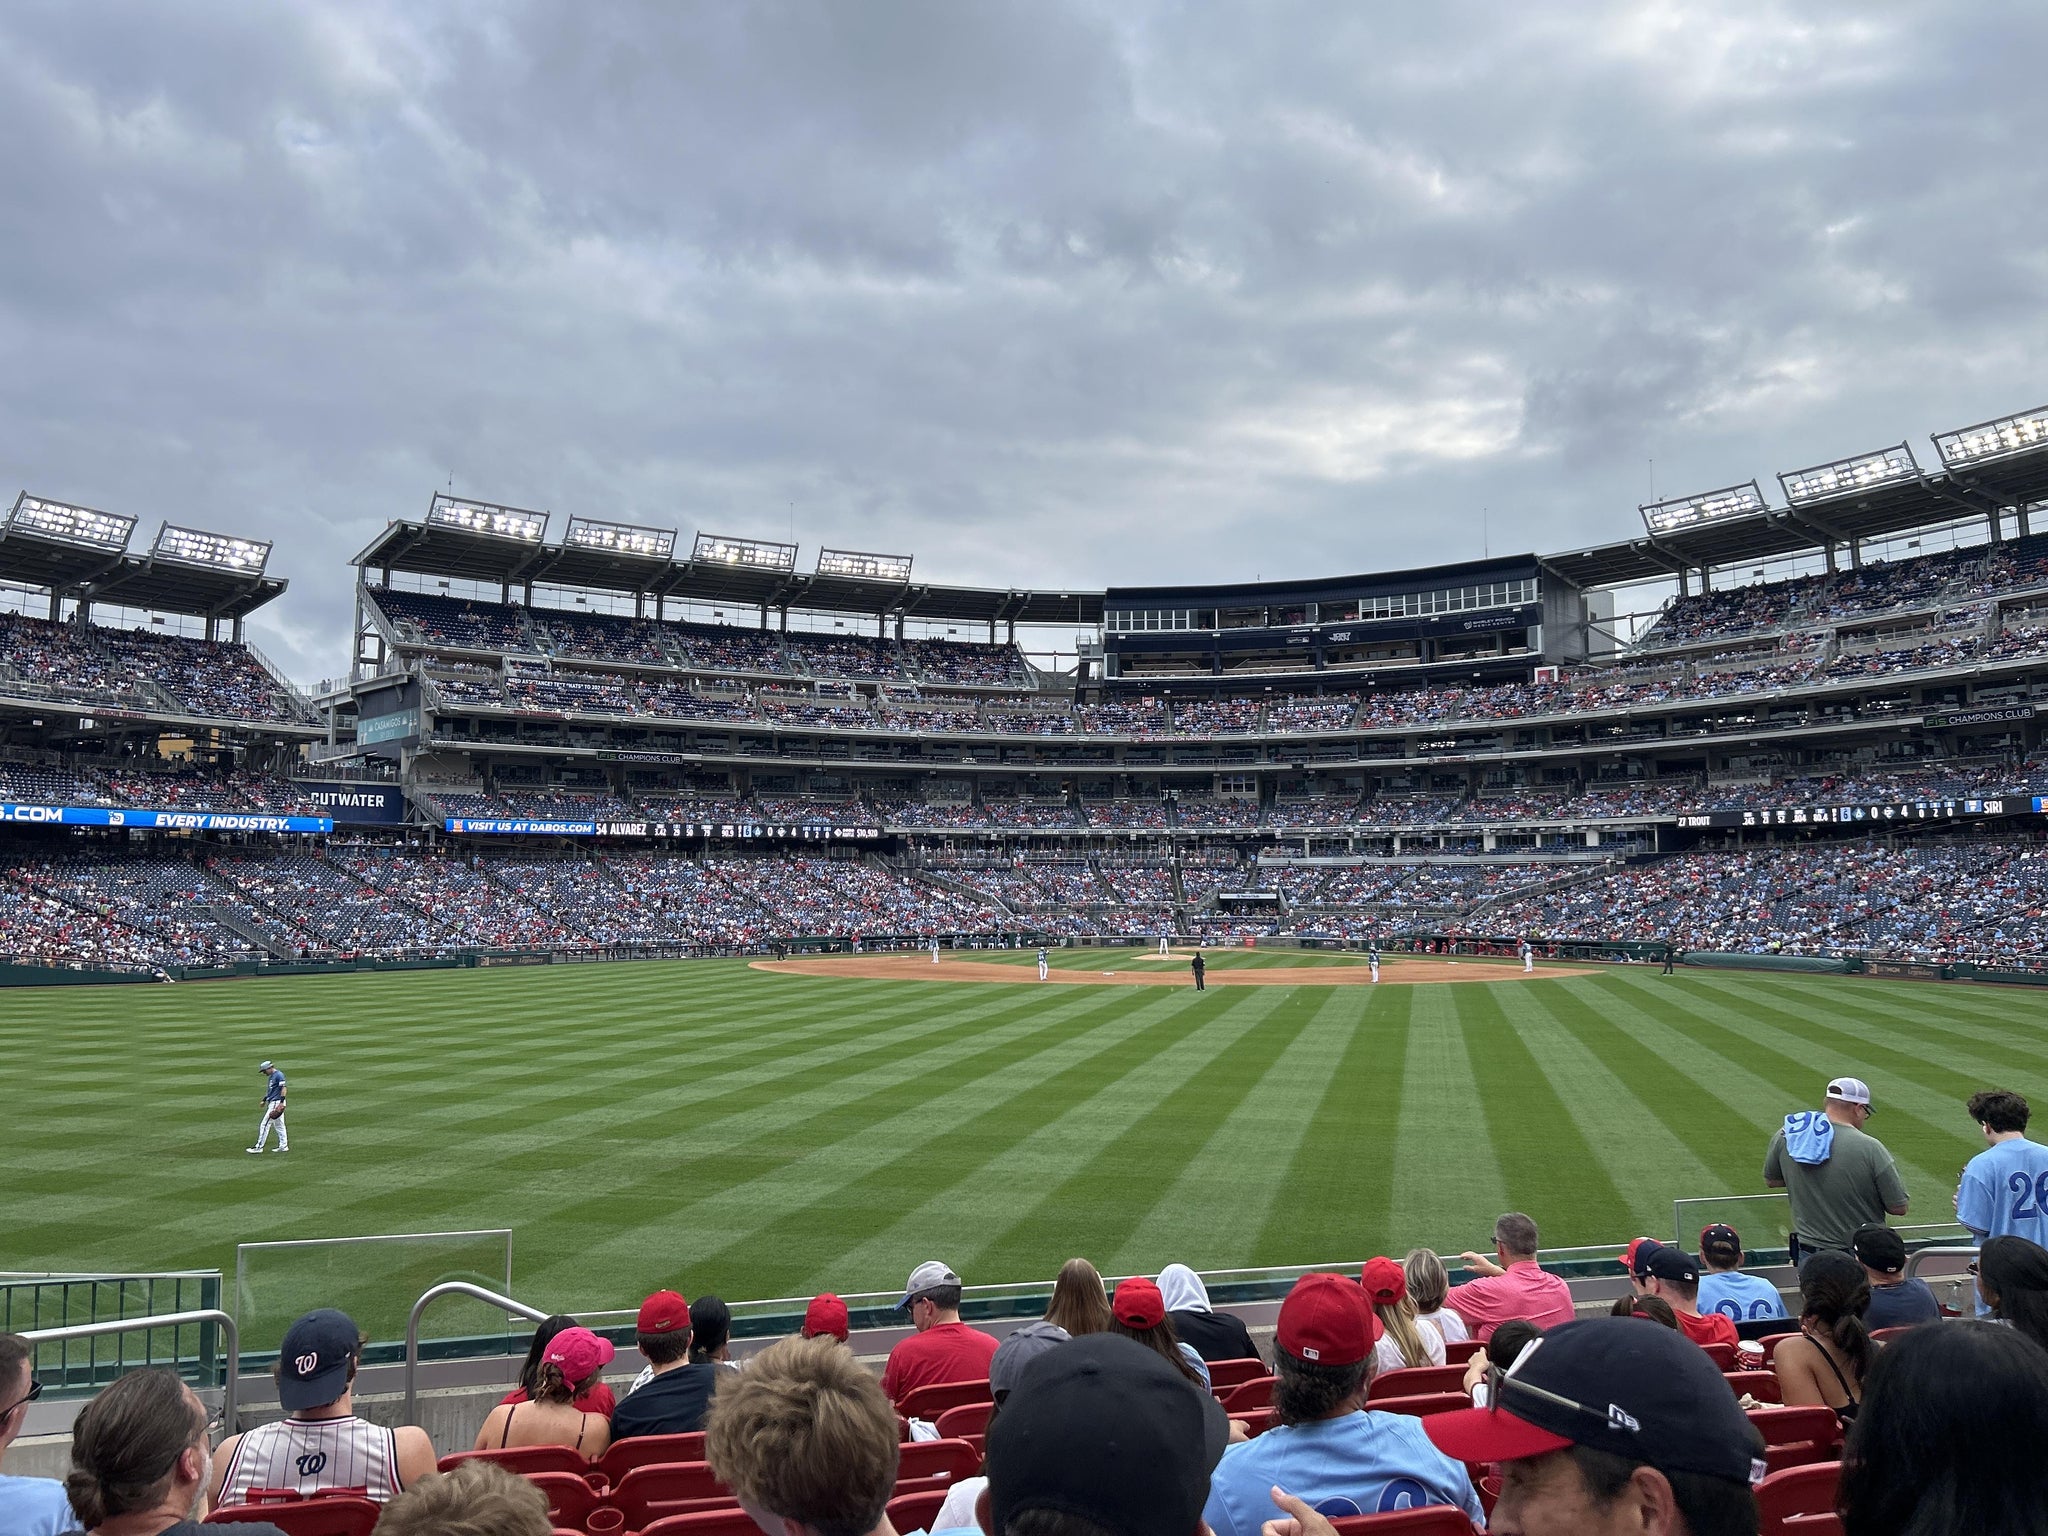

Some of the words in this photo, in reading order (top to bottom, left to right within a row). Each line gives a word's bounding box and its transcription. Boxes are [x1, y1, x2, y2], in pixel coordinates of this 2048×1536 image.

[1949, 711, 2003, 725] CHAMPIONS
[2005, 708, 2031, 719] CLUB
[618, 753, 660, 762] CHAMPIONS
[661, 755, 681, 763] CLUB
[1871, 806, 1879, 819] 0
[1901, 805, 1909, 817] 4
[1947, 808, 1953, 817] 0
[1983, 800, 2003, 814] SIRI
[1919, 809, 1925, 818] 0
[1933, 809, 1939, 818] 2
[155, 813, 208, 827] EVERY
[208, 815, 290, 830] INDUSTRY.
[1678, 817, 1686, 827] 27
[1688, 816, 1710, 826] TROUT
[1777, 815, 1786, 824] 52
[467, 821, 497, 831] VISIT
[497, 822, 512, 831] US
[513, 822, 527, 832] AT
[530, 823, 593, 833] DABOS.COM
[596, 823, 607, 835] 54
[609, 823, 647, 836] ALVAREZ
[767, 826, 774, 837] 0
[790, 827, 797, 837] 4
[815, 831, 820, 839] 2
[1212, 837, 1231, 845] PNC
[295, 1351, 318, 1375] W
[296, 1451, 327, 1477] W
